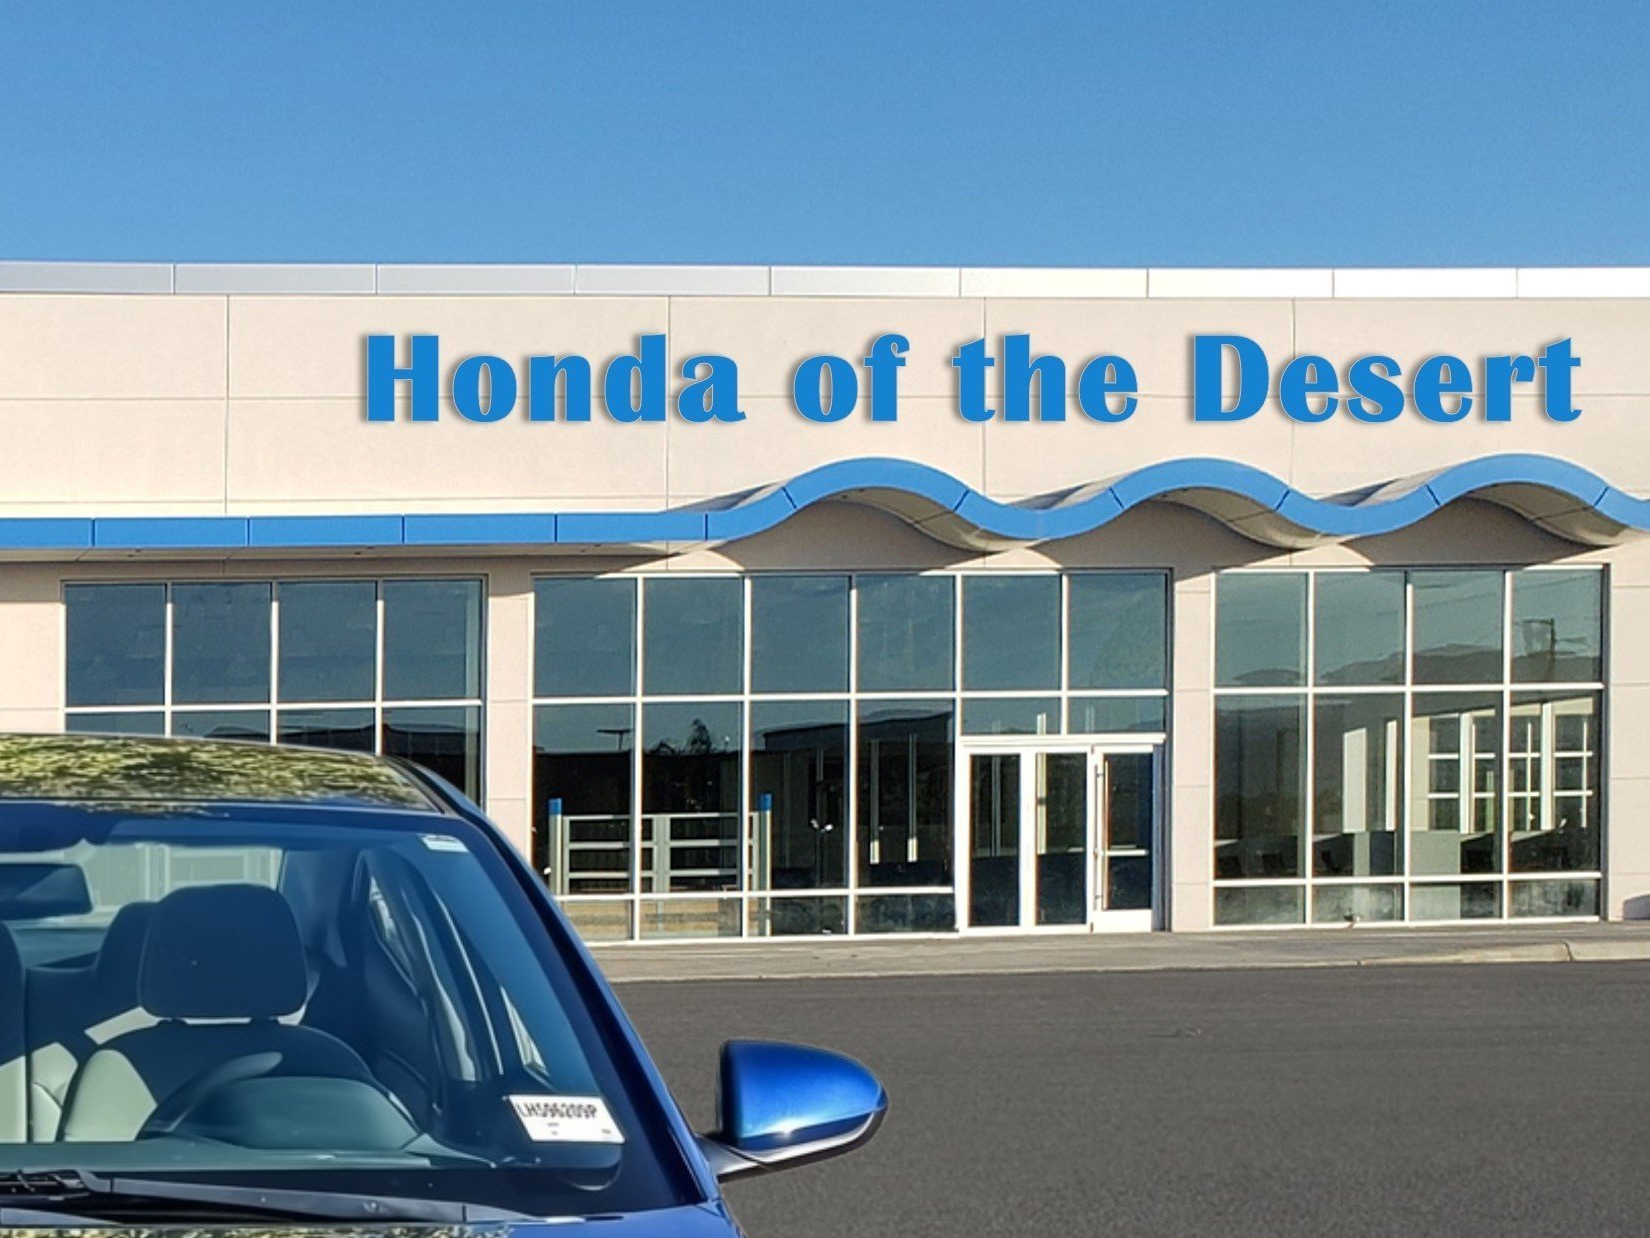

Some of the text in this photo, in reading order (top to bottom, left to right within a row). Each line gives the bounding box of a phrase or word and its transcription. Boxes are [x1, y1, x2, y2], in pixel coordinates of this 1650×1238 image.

[365, 334, 1582, 424] Honda of the Desert
